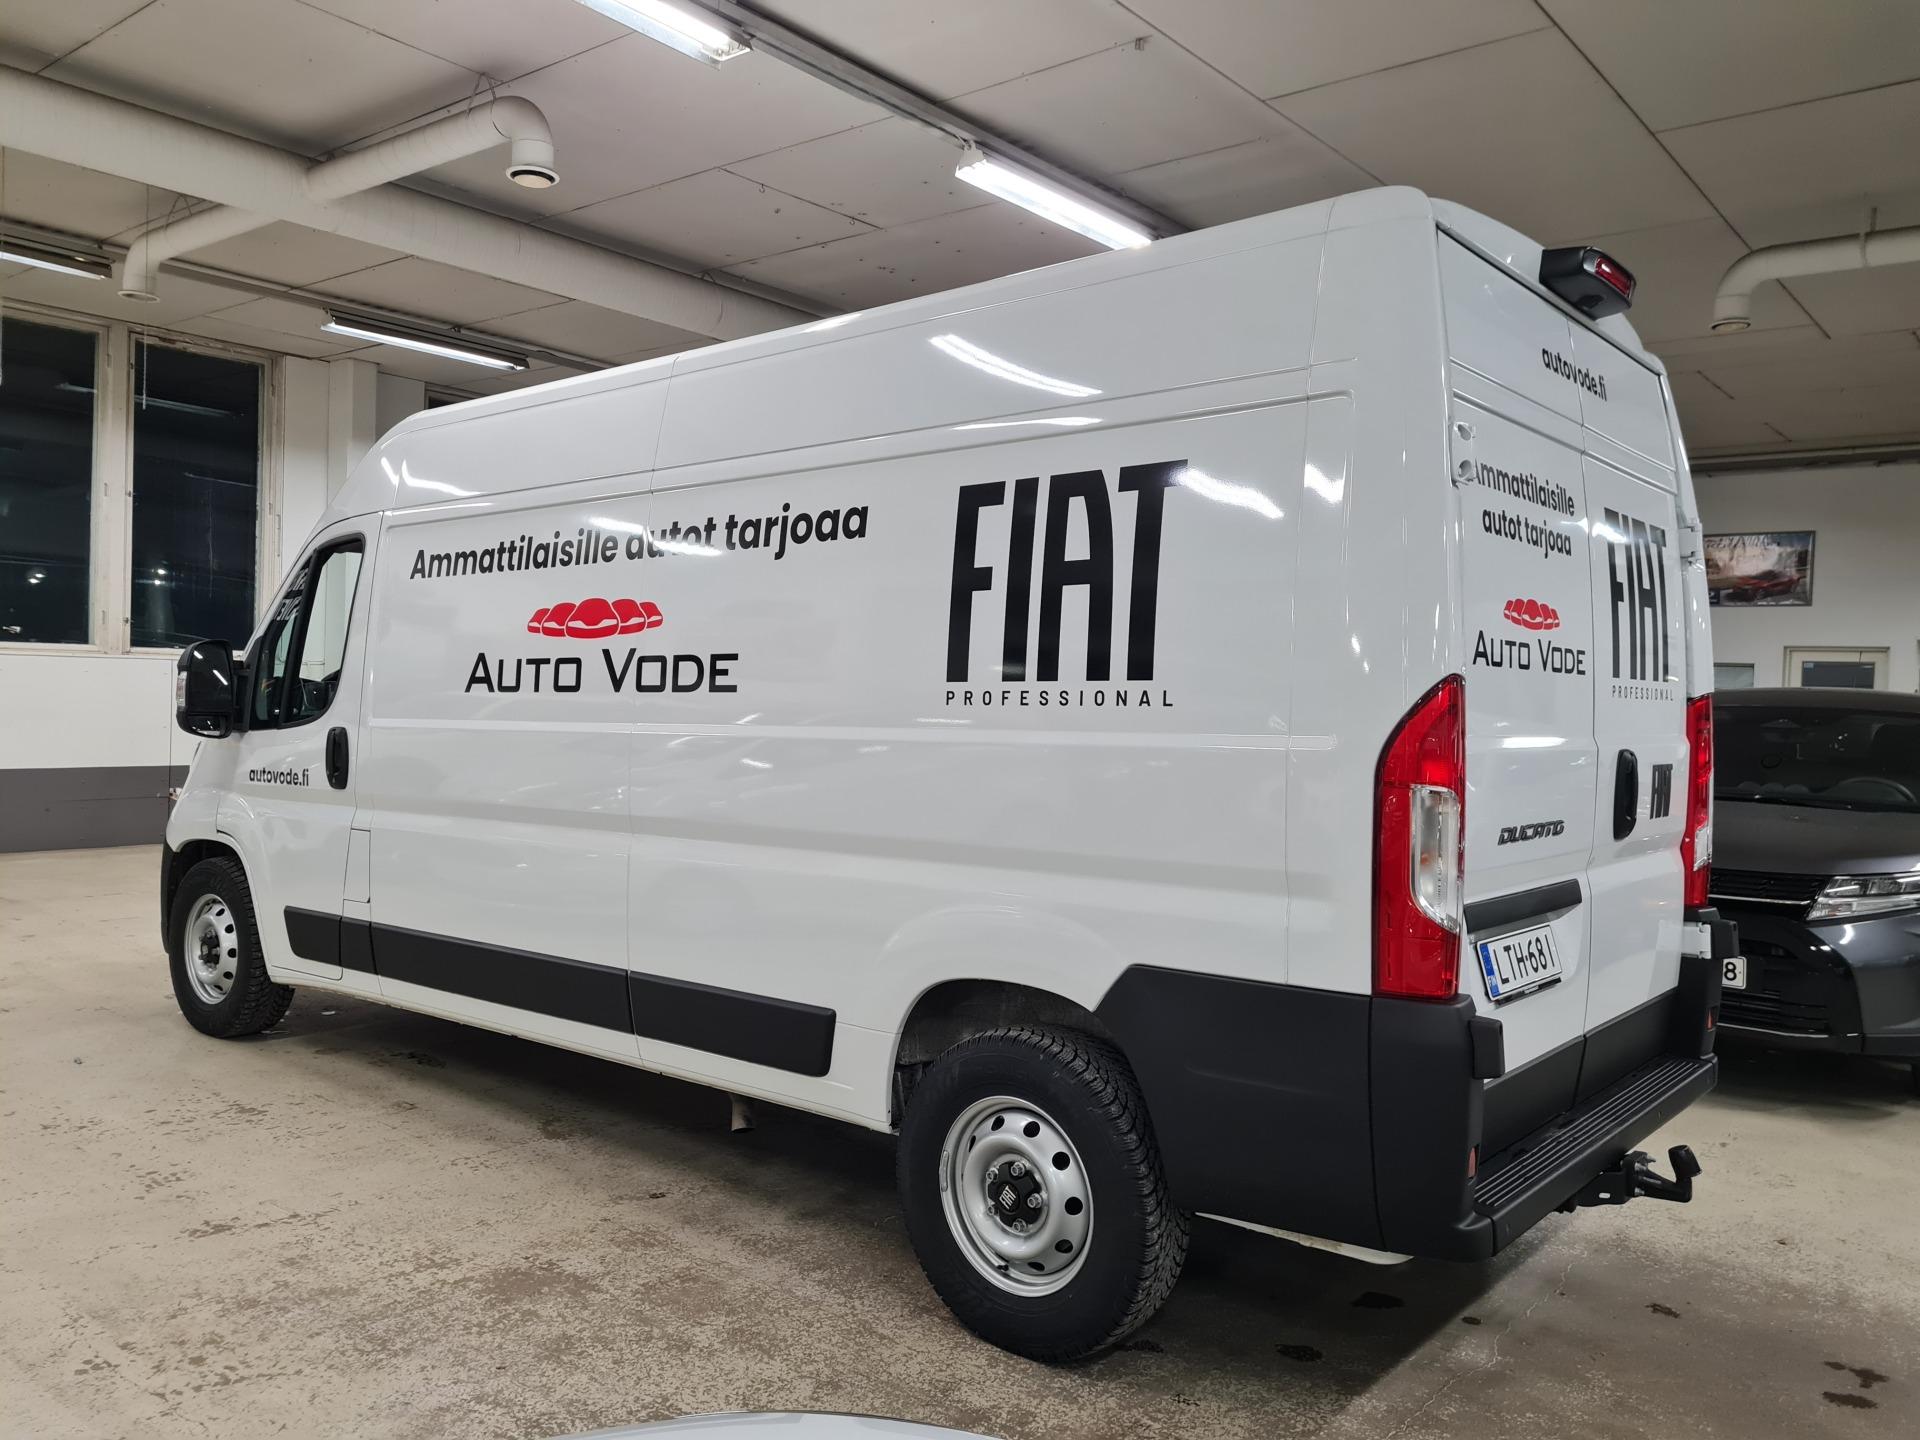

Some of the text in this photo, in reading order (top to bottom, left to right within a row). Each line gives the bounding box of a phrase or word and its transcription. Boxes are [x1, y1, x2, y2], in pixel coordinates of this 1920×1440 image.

[1542, 348, 1607, 402] autovode.fi
[410, 502, 869, 579] Ammattilaisille autot tarjoaa
[1482, 509, 1571, 559] autot tarjoaa
[946, 459, 1188, 682] FIAT
[1604, 507, 1668, 683] FIAT
[464, 648, 739, 692] AUTO VODE
[1472, 630, 1586, 675] AUTO VODE
[946, 690, 1173, 707] PROFESSIONAL
[1612, 685, 1674, 701] PROFESSIONAL
[249, 768, 309, 786] autovode.fi
[1497, 820, 1564, 845] DUCATO
[1493, 934, 1555, 984] LTH-681
